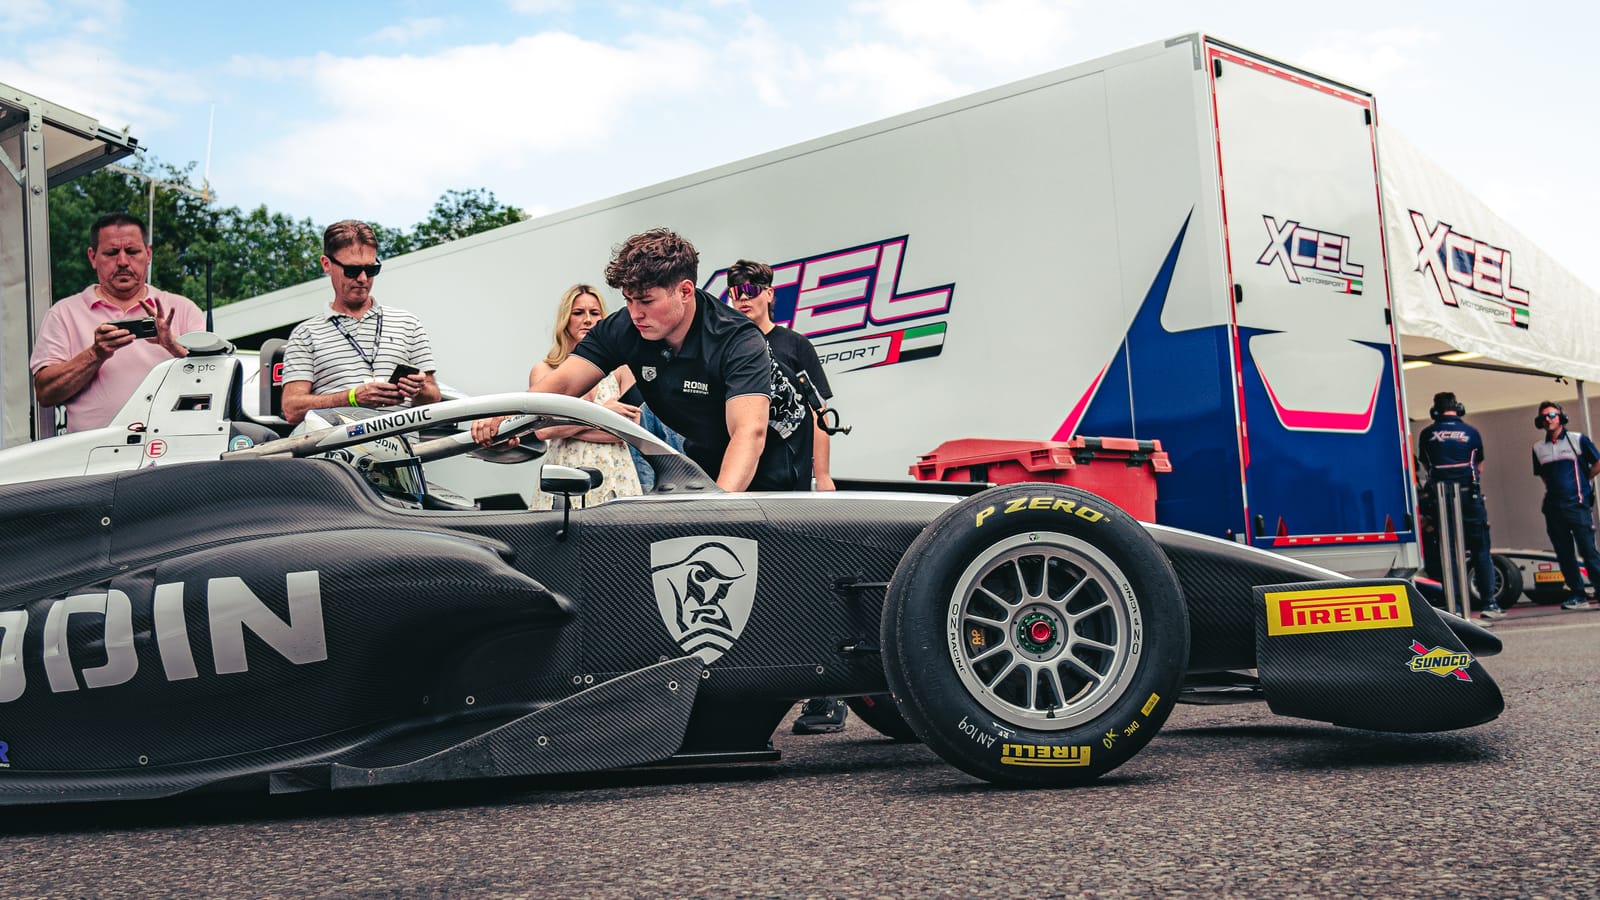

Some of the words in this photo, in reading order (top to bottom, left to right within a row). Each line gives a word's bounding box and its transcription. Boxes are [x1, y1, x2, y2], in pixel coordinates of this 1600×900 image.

[1256, 214, 1364, 284] XCEL
[1408, 209, 1530, 308] XCEL
[1301, 276, 1345, 288] MOTORSPORT
[1460, 299, 1509, 318] MOTORSPORT
[197, 363, 216, 374] ptc
[365, 409, 432, 433] NINOVIC
[150, 443, 163, 456] E
[975, 506, 996, 528] P
[1279, 593, 1399, 627] PIRELLI
[1413, 654, 1468, 669] SUNOCO
[1000, 743, 1092, 767] PIRELLI
